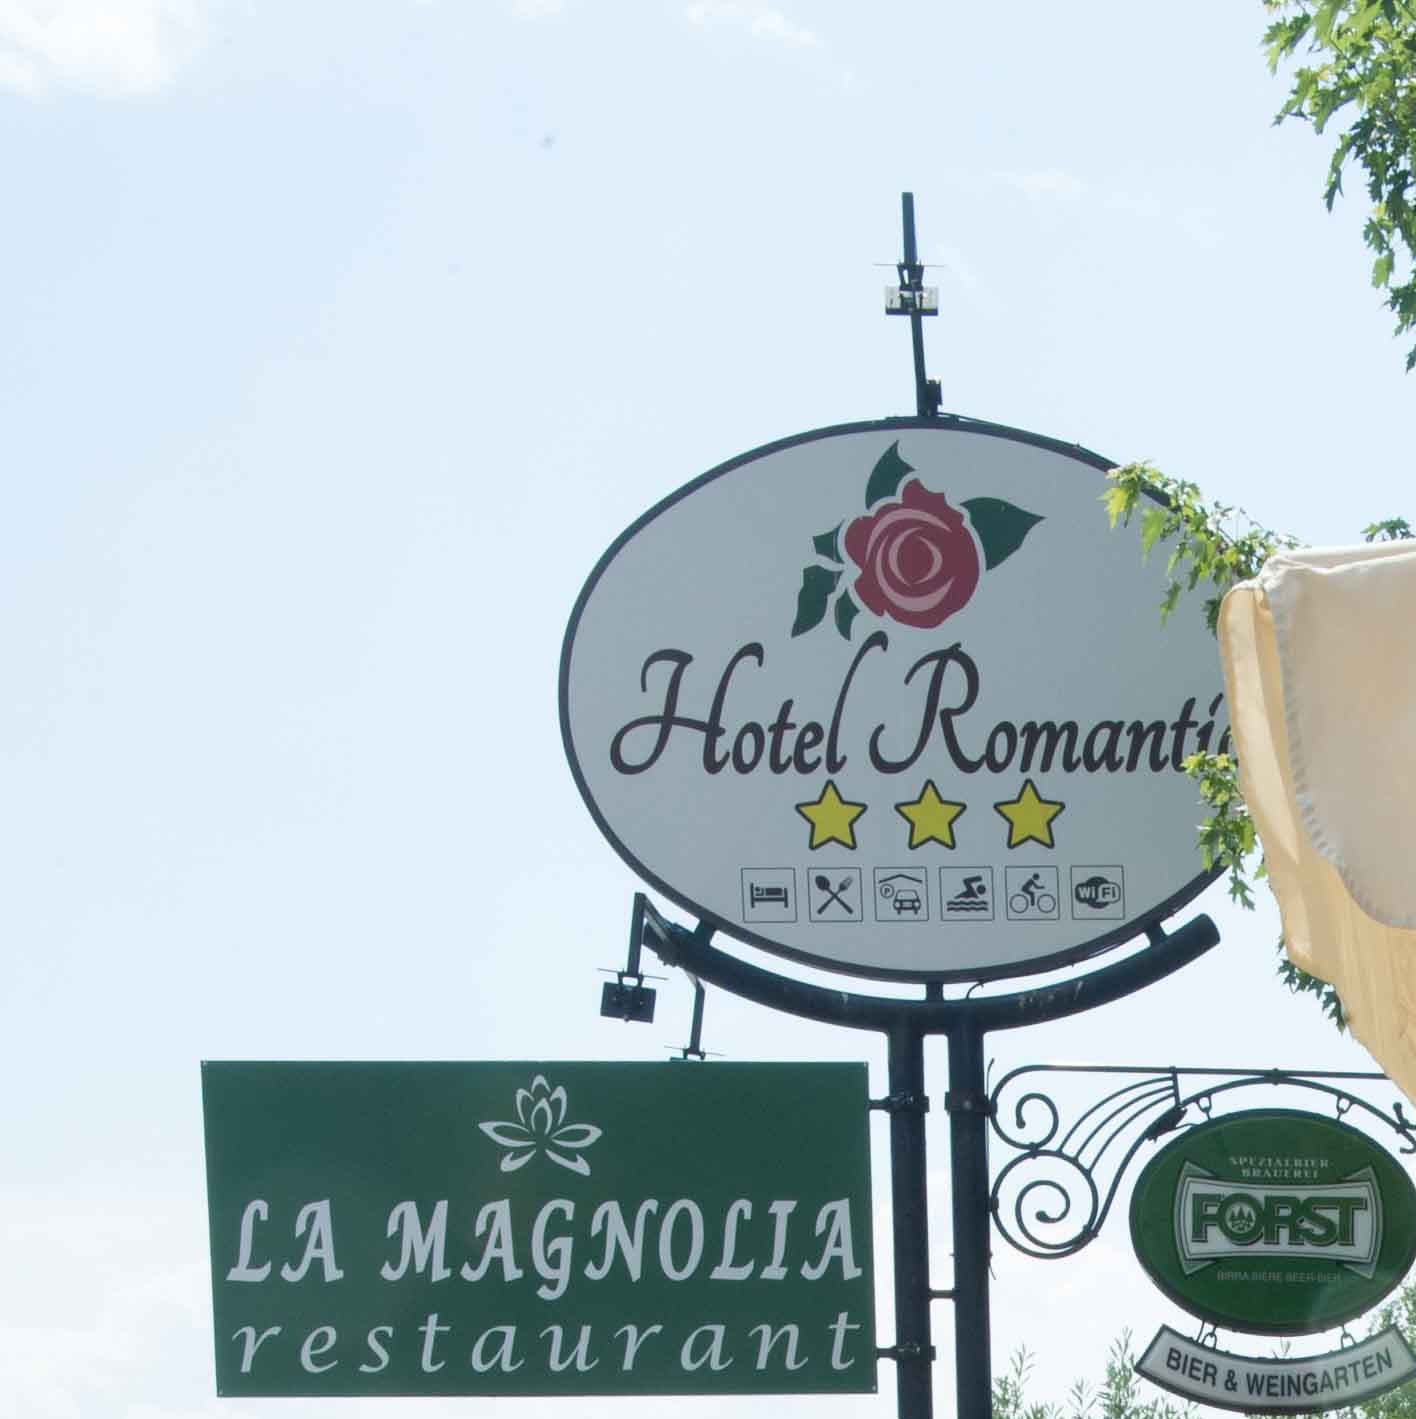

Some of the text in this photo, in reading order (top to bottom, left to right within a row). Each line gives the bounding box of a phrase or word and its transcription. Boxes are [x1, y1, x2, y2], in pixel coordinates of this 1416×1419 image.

[609, 630, 888, 775] Hotel
[226, 1198, 863, 1301] LA MAGNOLIA
[1191, 1192, 1368, 1247] FORST
[231, 1311, 861, 1374] restaurant
[1166, 1347, 1393, 1398] BIER & WEINGARTEN
